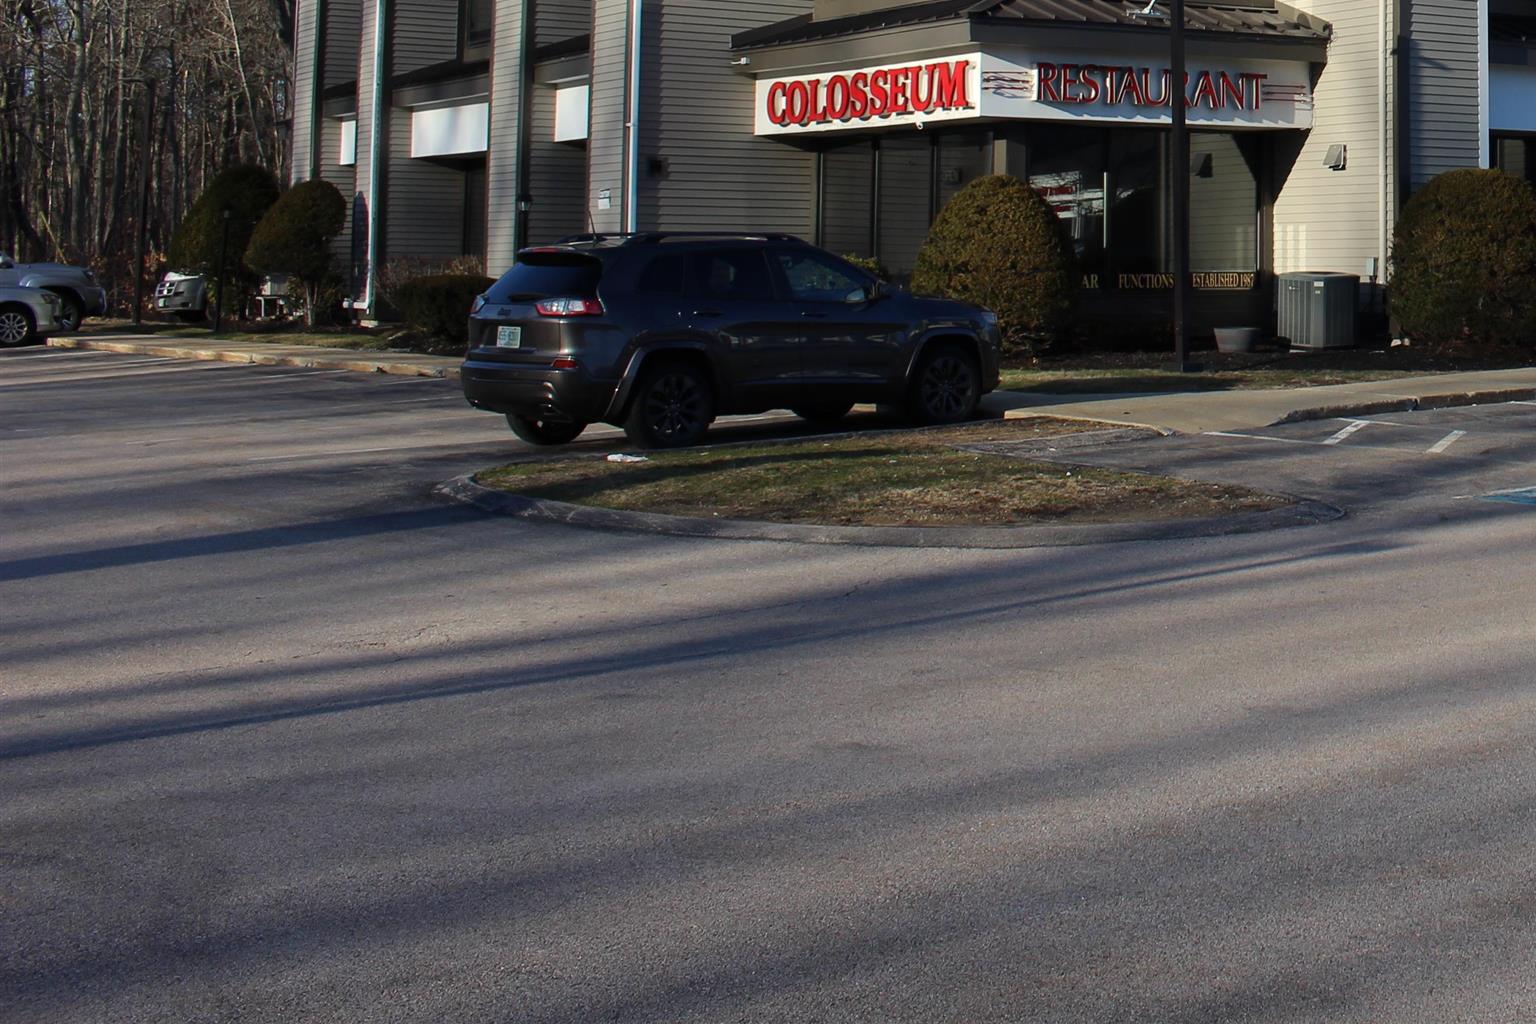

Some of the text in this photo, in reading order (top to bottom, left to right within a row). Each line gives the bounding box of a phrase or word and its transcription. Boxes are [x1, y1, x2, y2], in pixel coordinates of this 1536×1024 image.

[767, 60, 970, 125] COLOSSEUM
[1081, 273, 1176, 289] AR FUNCTIONS
[1192, 273, 1239, 289] ESTABLISHED
